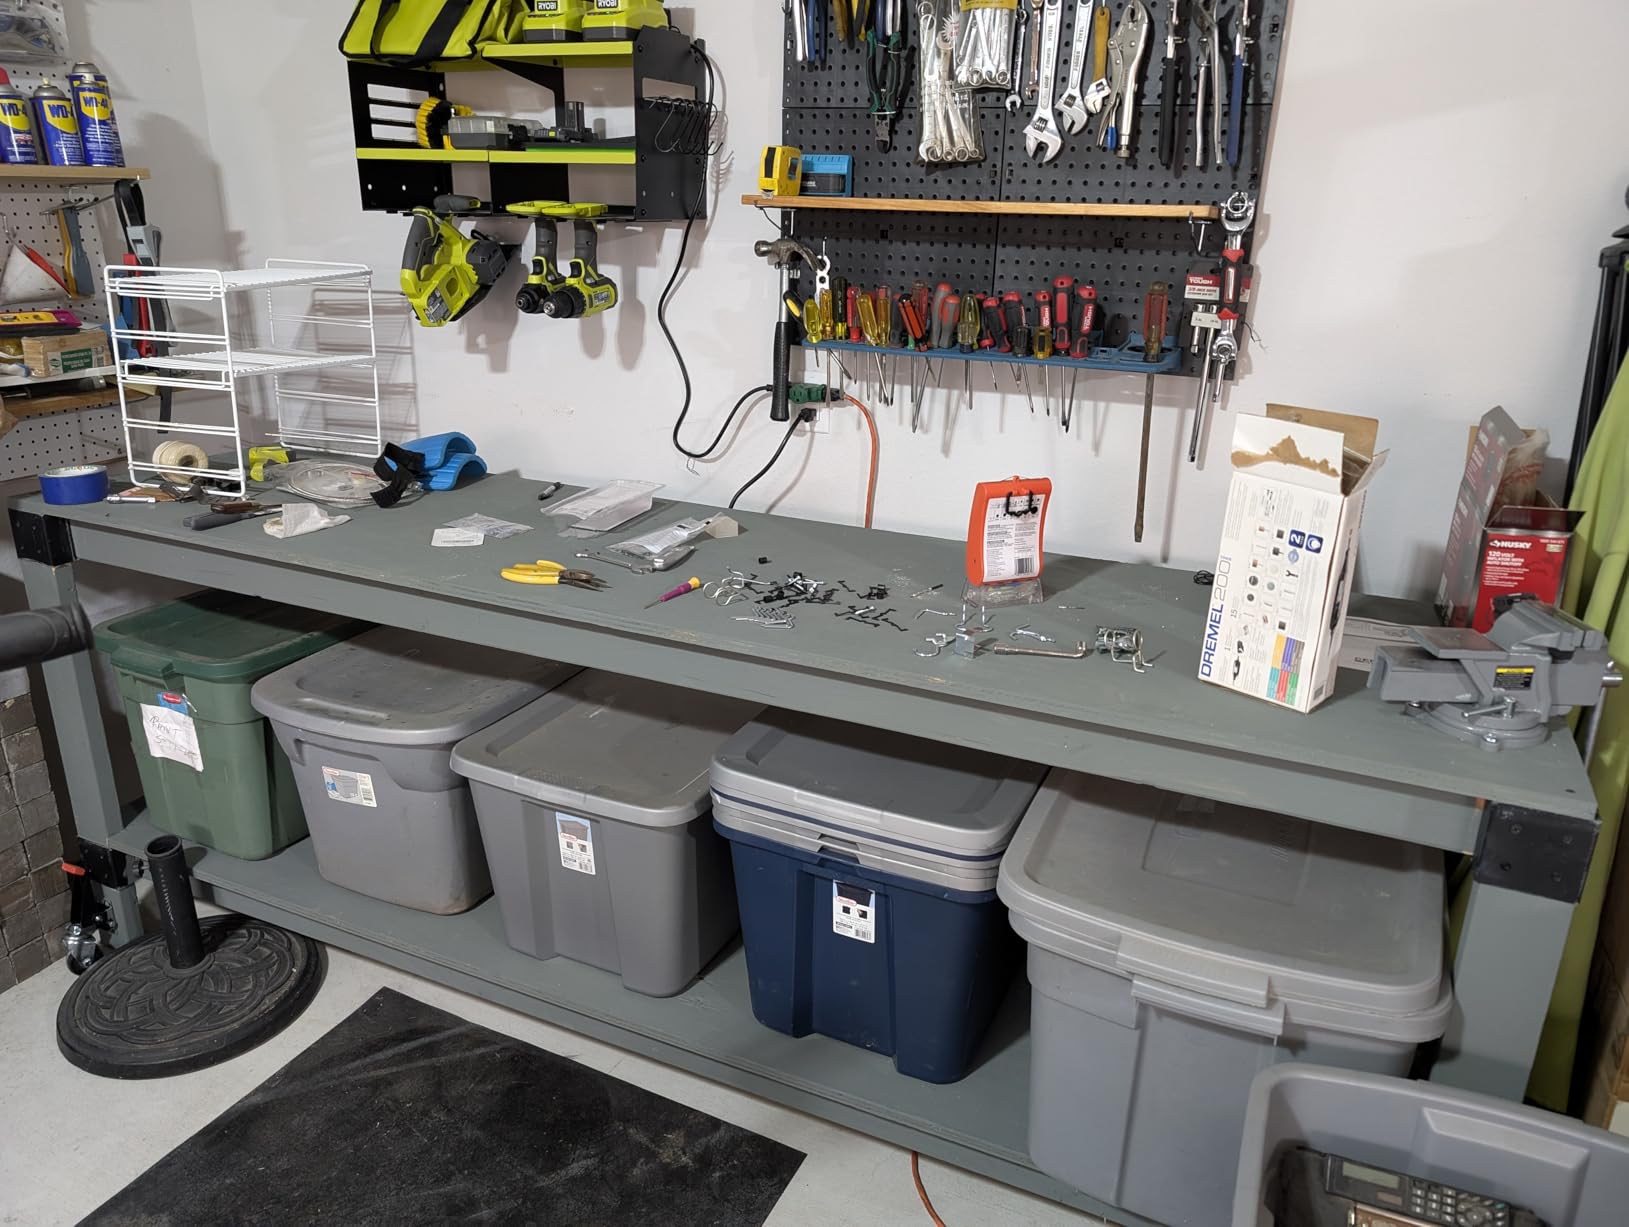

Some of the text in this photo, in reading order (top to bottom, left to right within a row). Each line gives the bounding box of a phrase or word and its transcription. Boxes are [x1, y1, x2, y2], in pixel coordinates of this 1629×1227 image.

[538, 2, 556, 10] RYOBI
[0, 103, 28, 117] WD-4
[1500, 541, 1532, 549] HUSKY
[1201, 604, 1224, 677] DREMEL
[1214, 560, 1231, 601] 200
